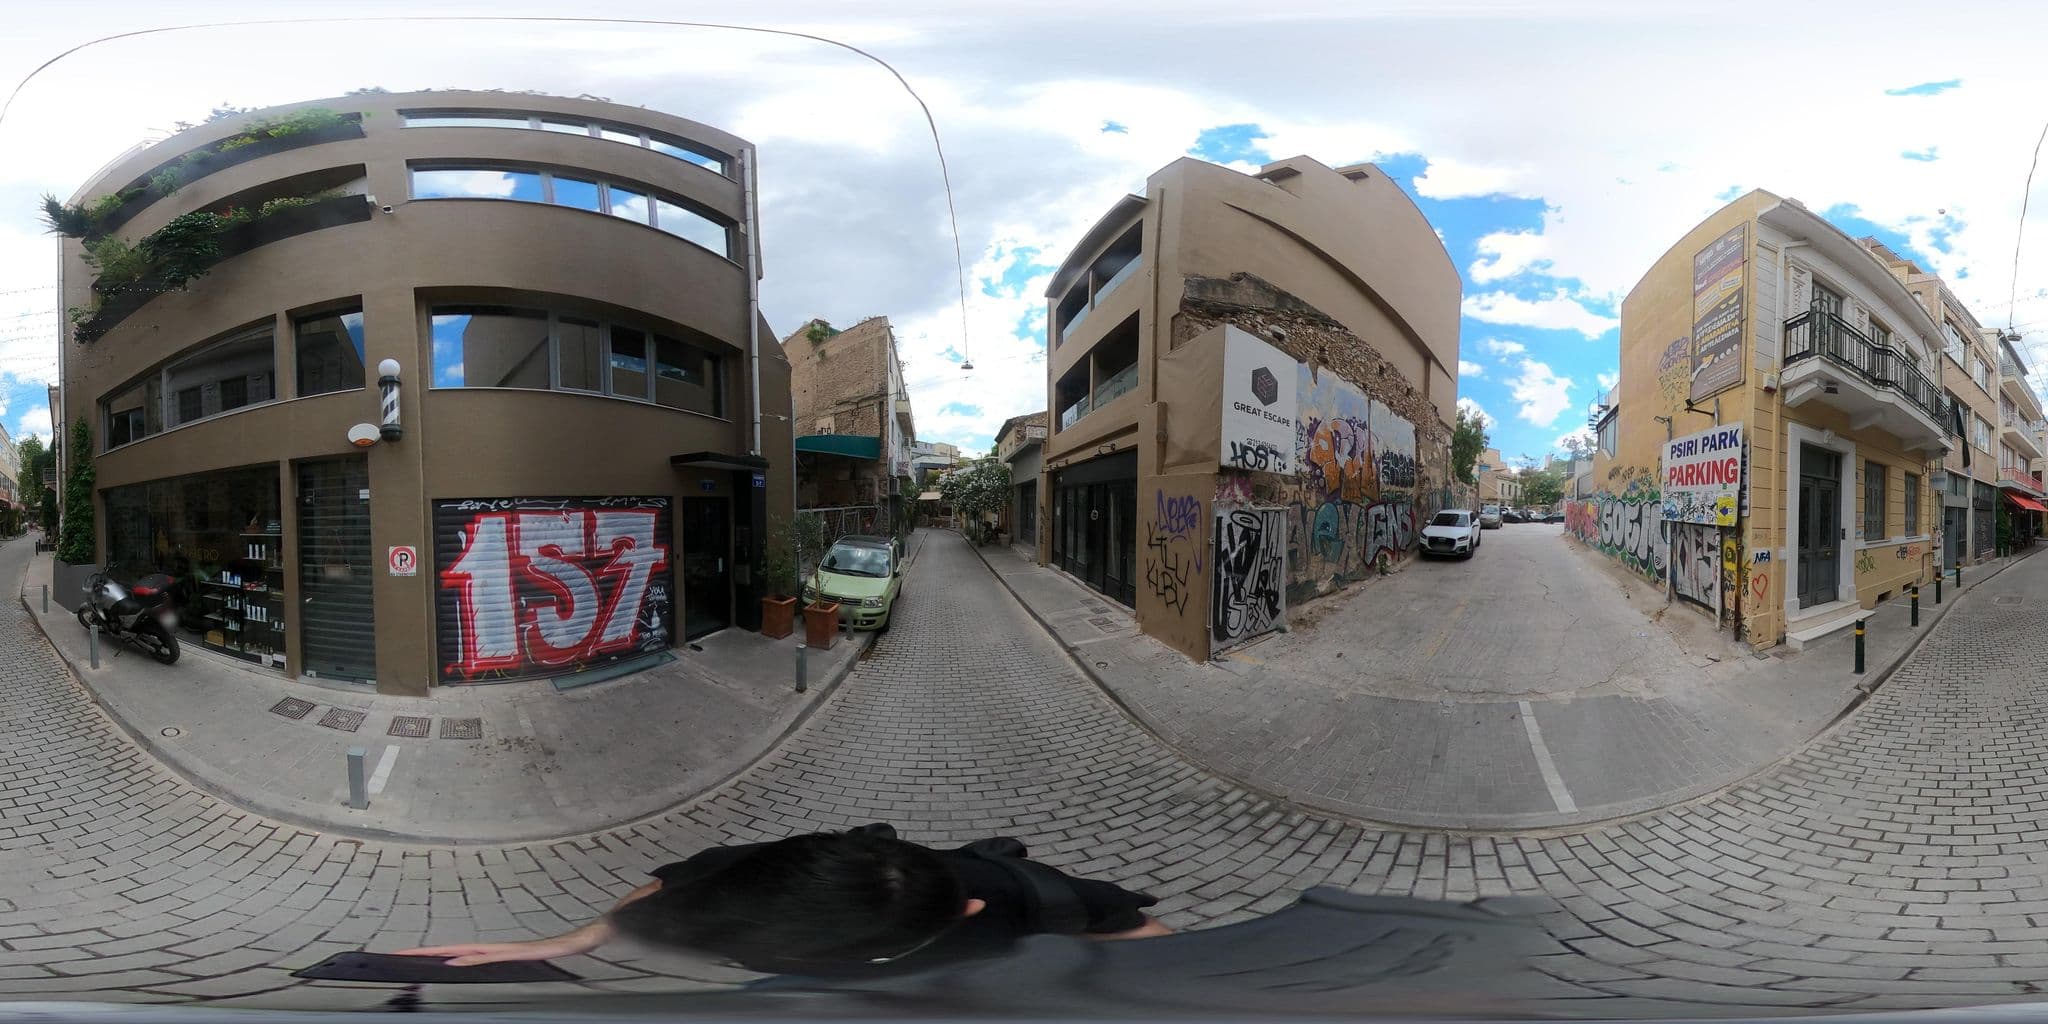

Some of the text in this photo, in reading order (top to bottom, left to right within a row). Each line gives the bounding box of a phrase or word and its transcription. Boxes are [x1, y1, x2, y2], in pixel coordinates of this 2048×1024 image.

[1233, 401, 1291, 427] GREAT ESCAPE
[1670, 428, 1740, 460] PSIRI PARK
[1668, 457, 1738, 487] PARKING
[445, 510, 664, 668] 157
